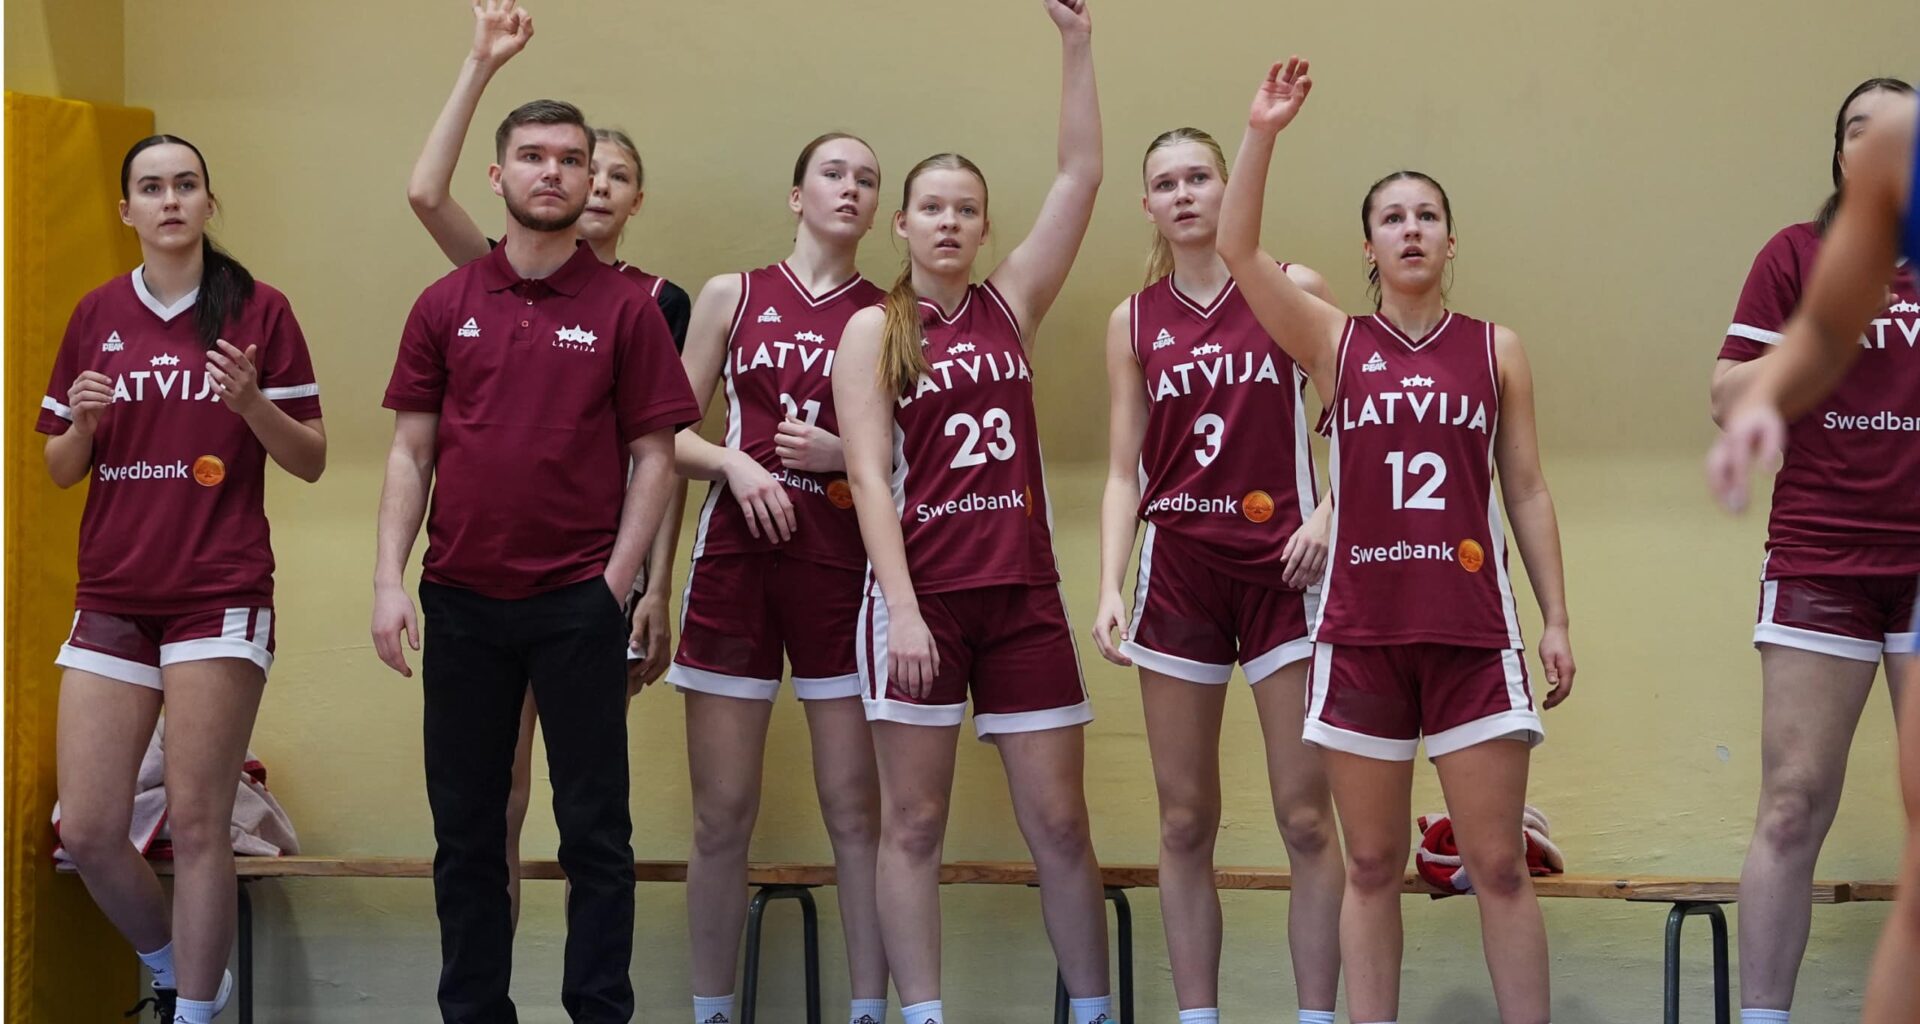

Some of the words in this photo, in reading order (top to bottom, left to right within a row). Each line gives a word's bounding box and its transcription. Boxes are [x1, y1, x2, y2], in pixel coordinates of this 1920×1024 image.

[457, 328, 481, 338] PEAK
[757, 315, 782, 323] PEAK
[102, 342, 124, 352] PEAK
[551, 340, 595, 353] LATVIJA
[1153, 336, 1175, 350] PEAK
[737, 342, 835, 377] LATVI
[1362, 361, 1387, 372] PEAK
[111, 370, 221, 404] ATVIJ
[1147, 352, 1280, 402] ATVIJA
[1343, 392, 1487, 434] LATVIJA
[944, 407, 1016, 469] 23
[1194, 413, 1225, 467] 3
[1384, 451, 1447, 511] 12
[916, 490, 1025, 523] Swedbank
[1145, 493, 1238, 516] wedbank
[1350, 540, 1454, 564] Swedbank
